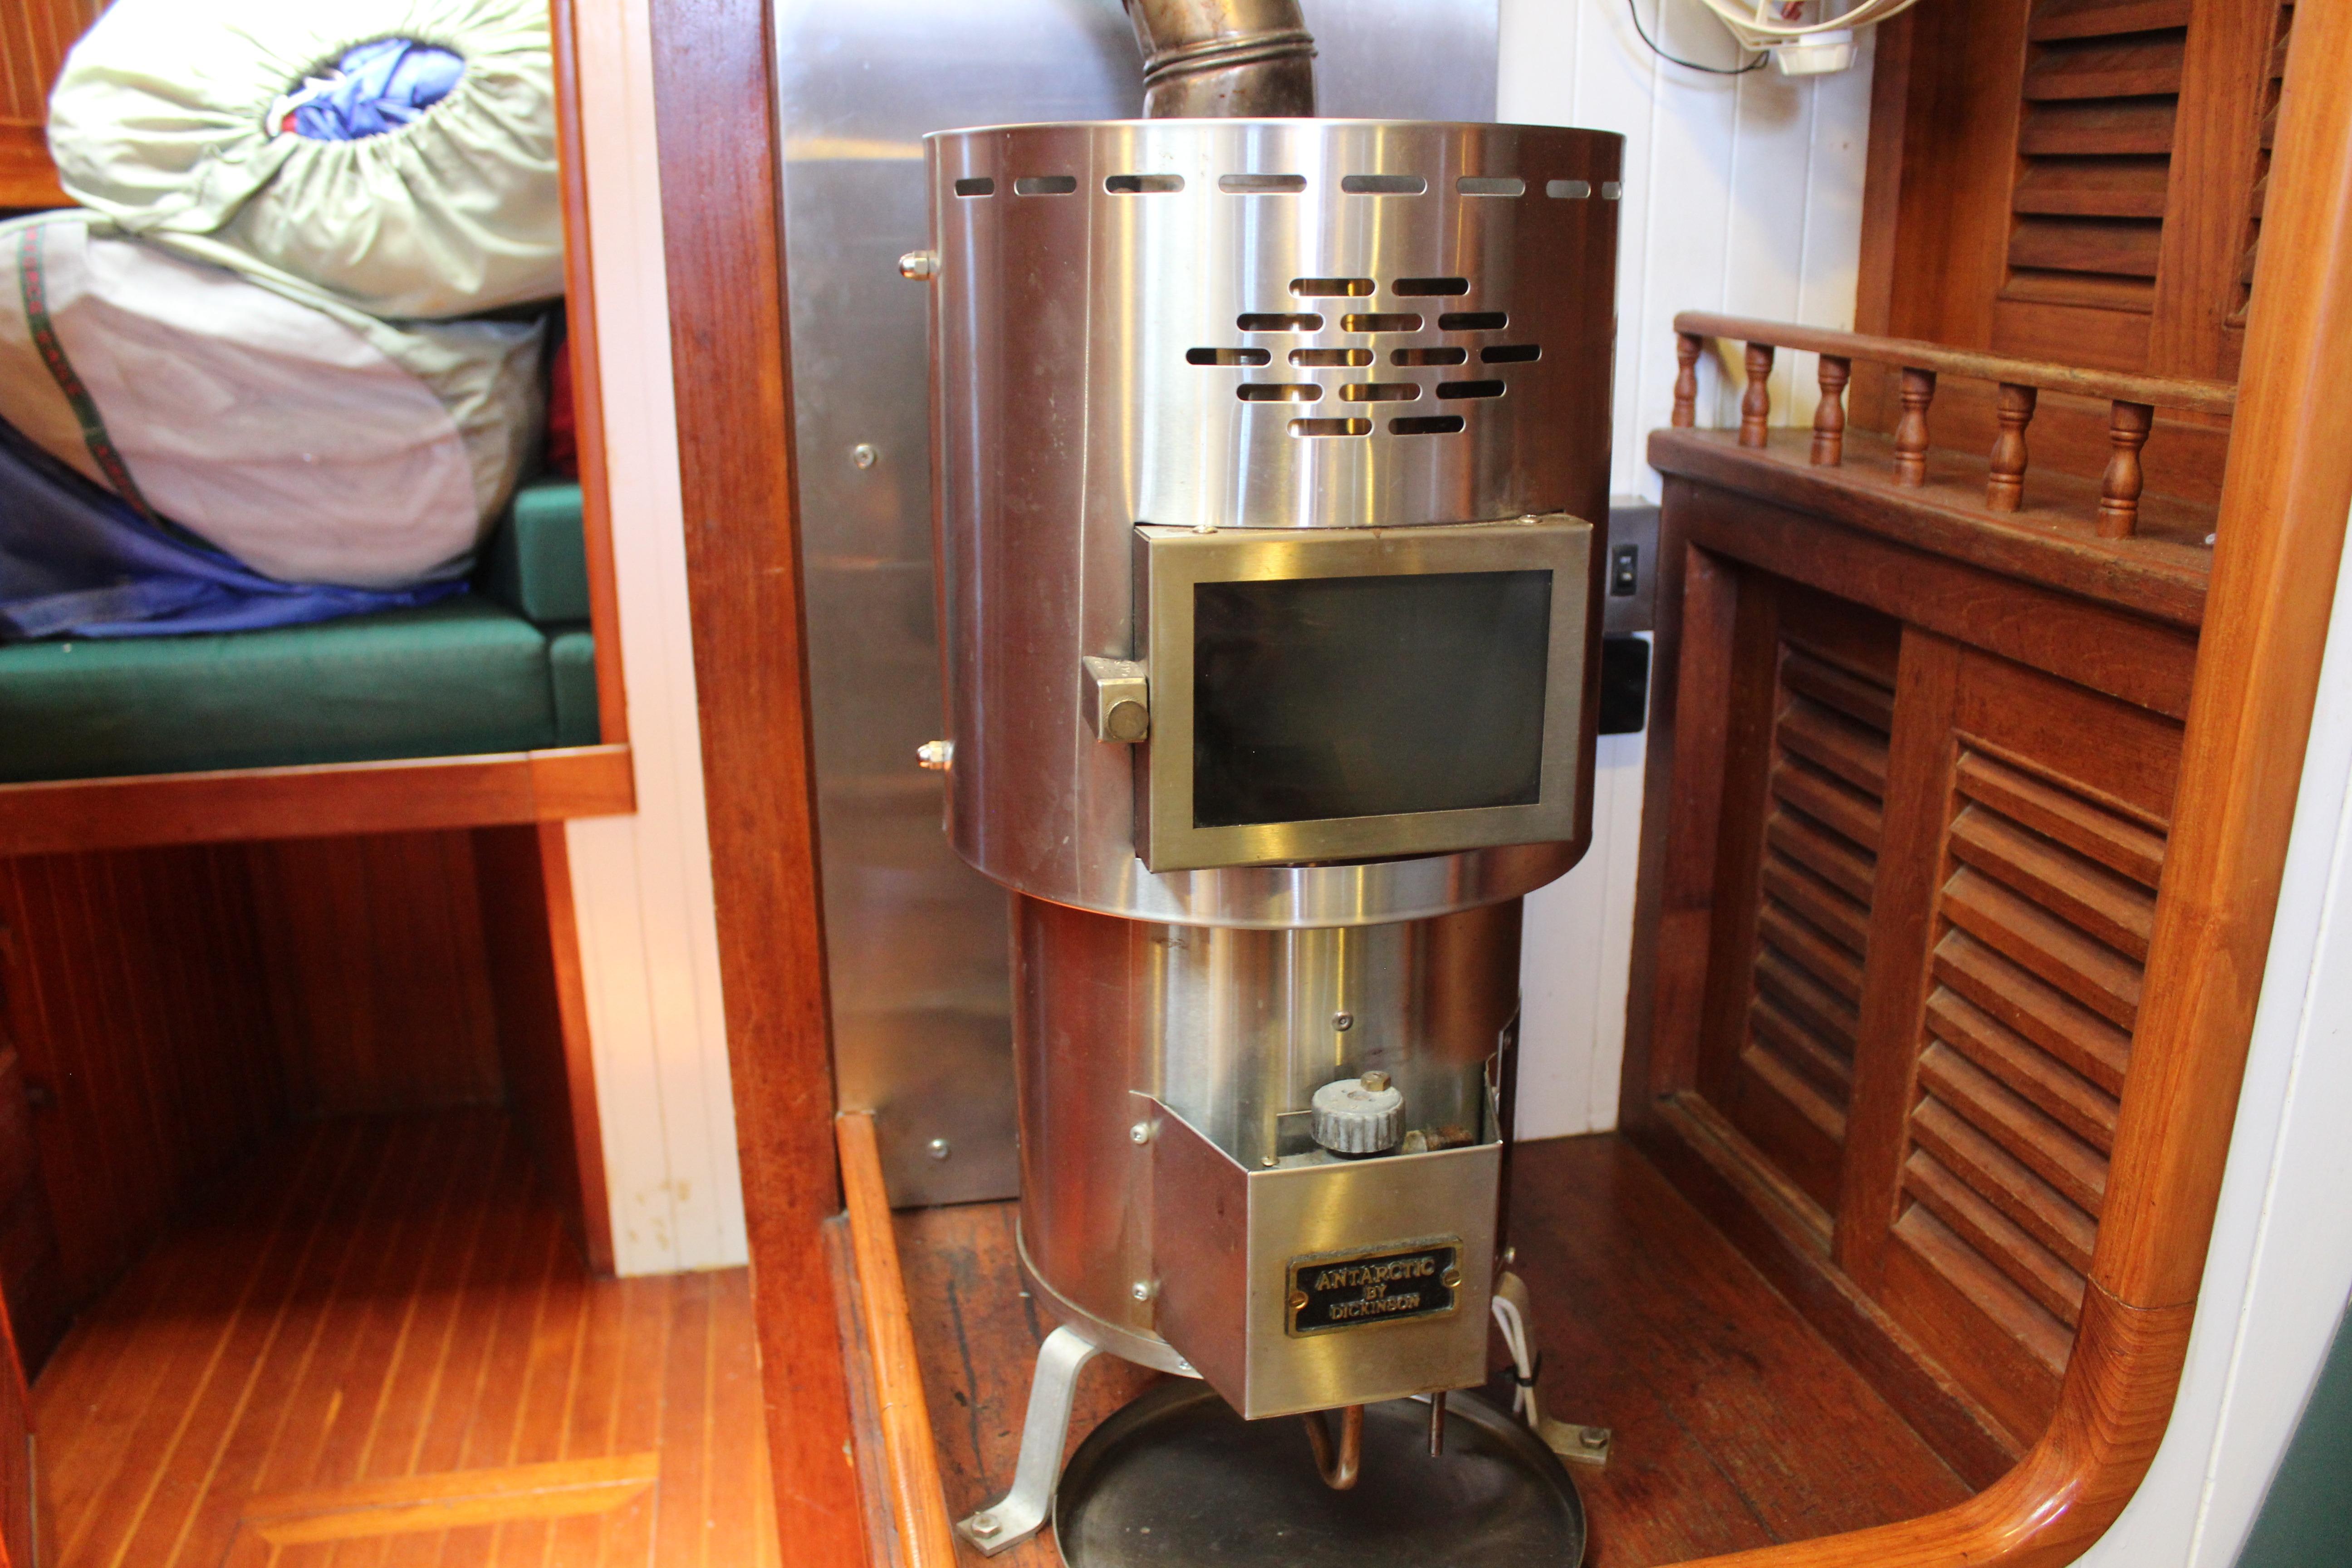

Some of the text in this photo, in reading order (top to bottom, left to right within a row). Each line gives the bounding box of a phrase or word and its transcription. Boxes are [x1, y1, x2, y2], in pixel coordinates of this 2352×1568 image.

[1317, 1257, 1435, 1291] ANTARCTIC
[1365, 1284, 1387, 1300] BY
[1330, 1293, 1420, 1320] DICKINSON
